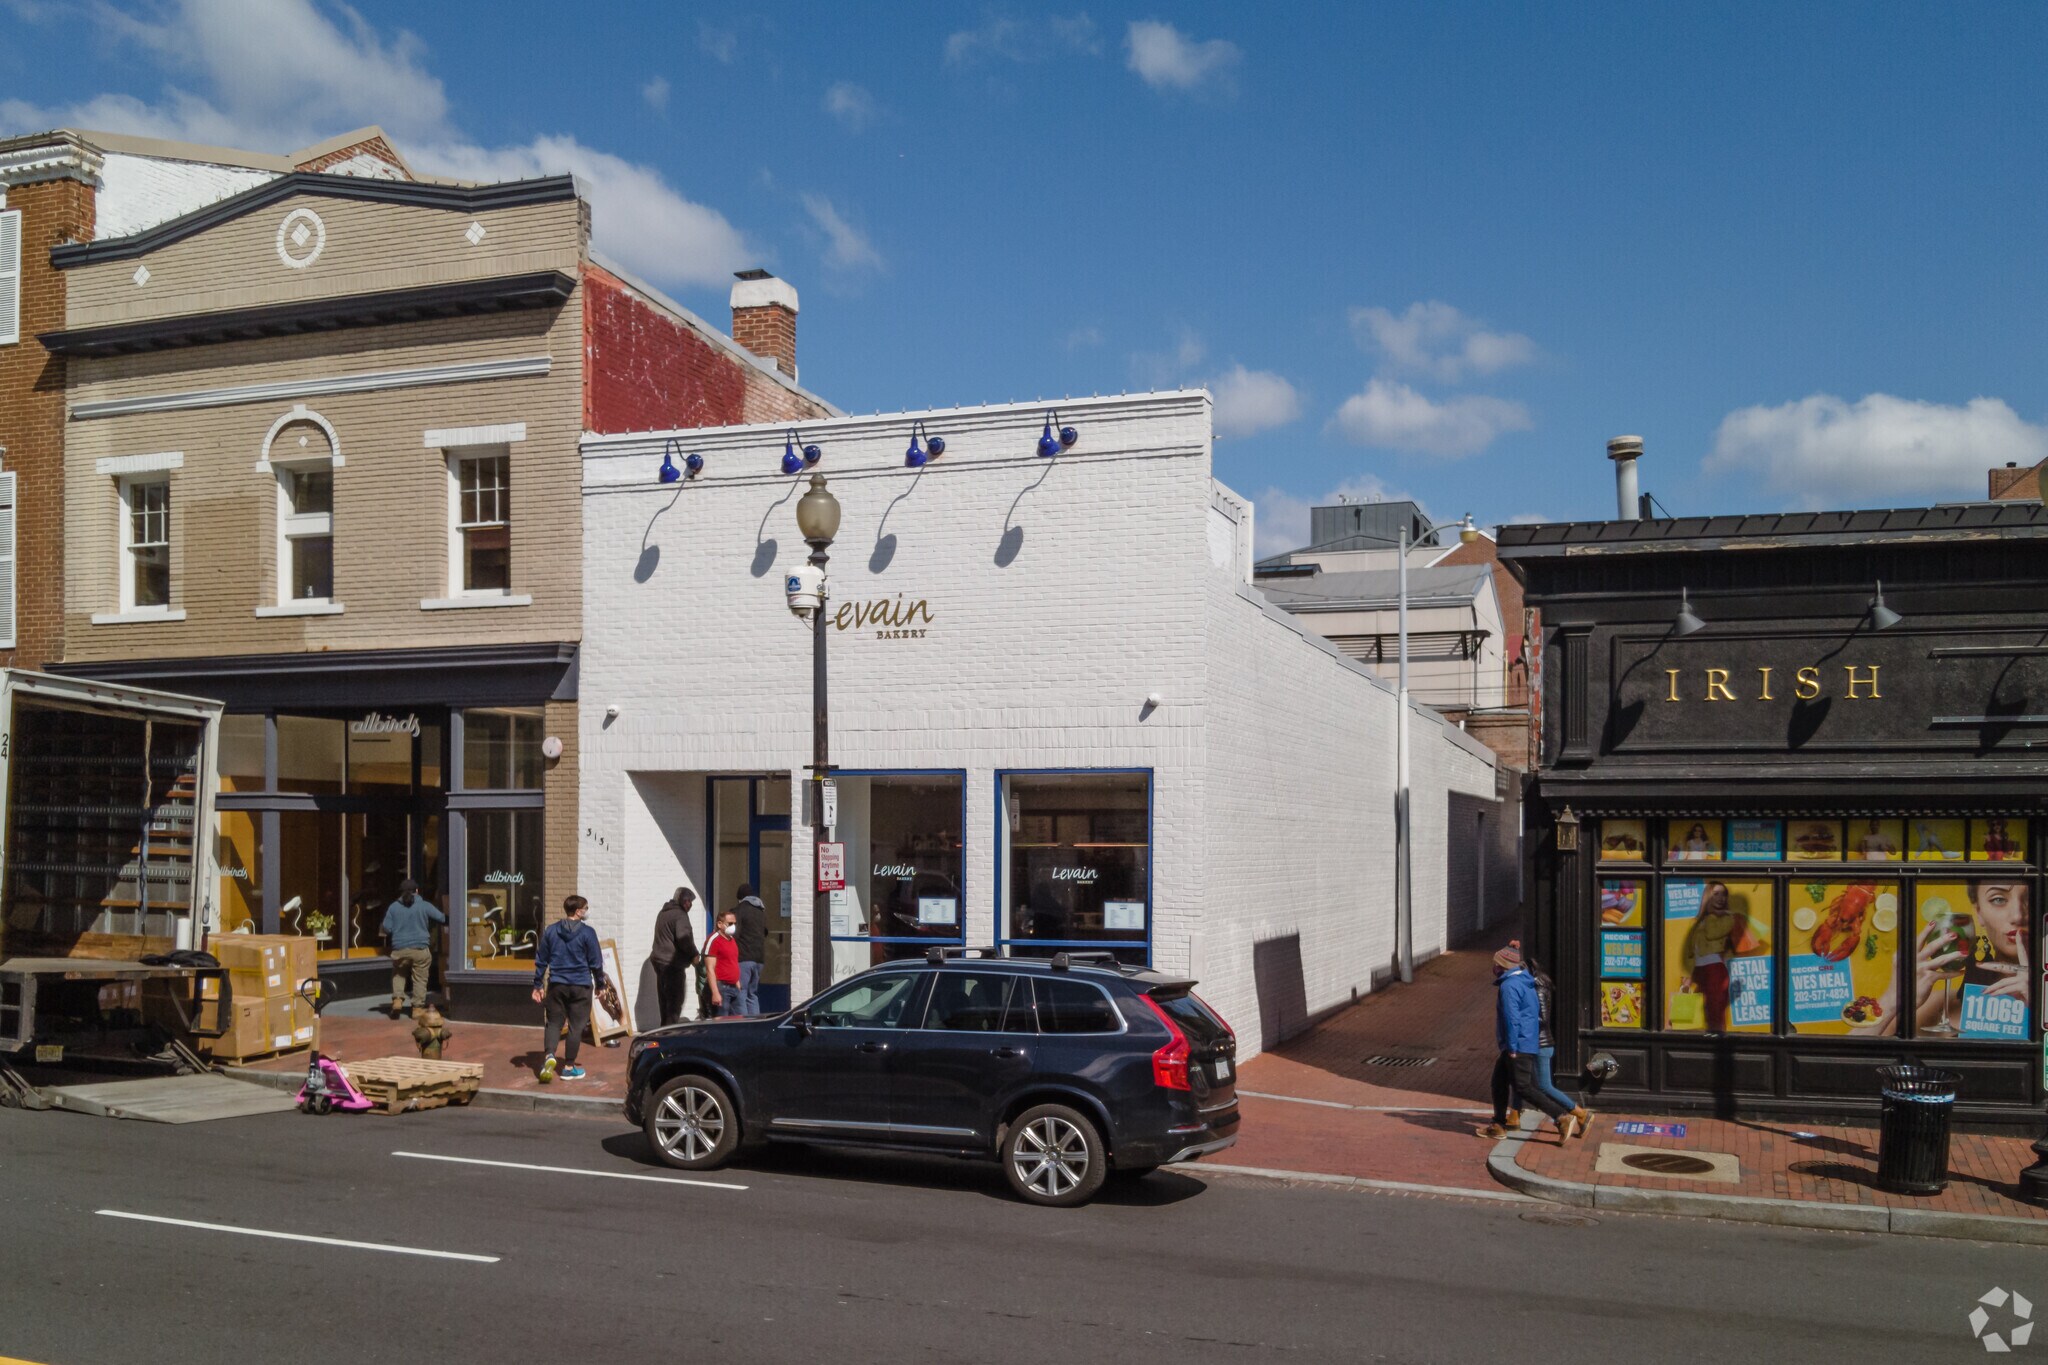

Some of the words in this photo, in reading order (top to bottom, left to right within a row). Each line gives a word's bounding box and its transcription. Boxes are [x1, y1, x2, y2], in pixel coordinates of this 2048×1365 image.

[876, 629, 927, 640] BAKERY
[1665, 665, 1882, 702] IRISH
[350, 711, 420, 737] allbirds
[820, 846, 830, 854] No
[220, 865, 248, 880] llbirds
[821, 862, 840, 870] Anytime
[873, 863, 917, 876] Levain
[1051, 865, 1099, 880] Levain
[484, 869, 525, 886] allbirds
[1668, 889, 1682, 900] WES
[1683, 888, 1700, 898] NEAL
[1605, 943, 1621, 956] WES
[1731, 960, 1770, 976] RETAIL
[1792, 974, 1817, 990] WES
[1819, 972, 1848, 988] NEAL
[1794, 988, 1850, 1002] 202-577-4824
[1735, 1005, 1771, 1022] LEASE
[1966, 995, 2025, 1025] 11,069
[1965, 1020, 2001, 1033] SQUARE
[2002, 1024, 2024, 1035] FEET
